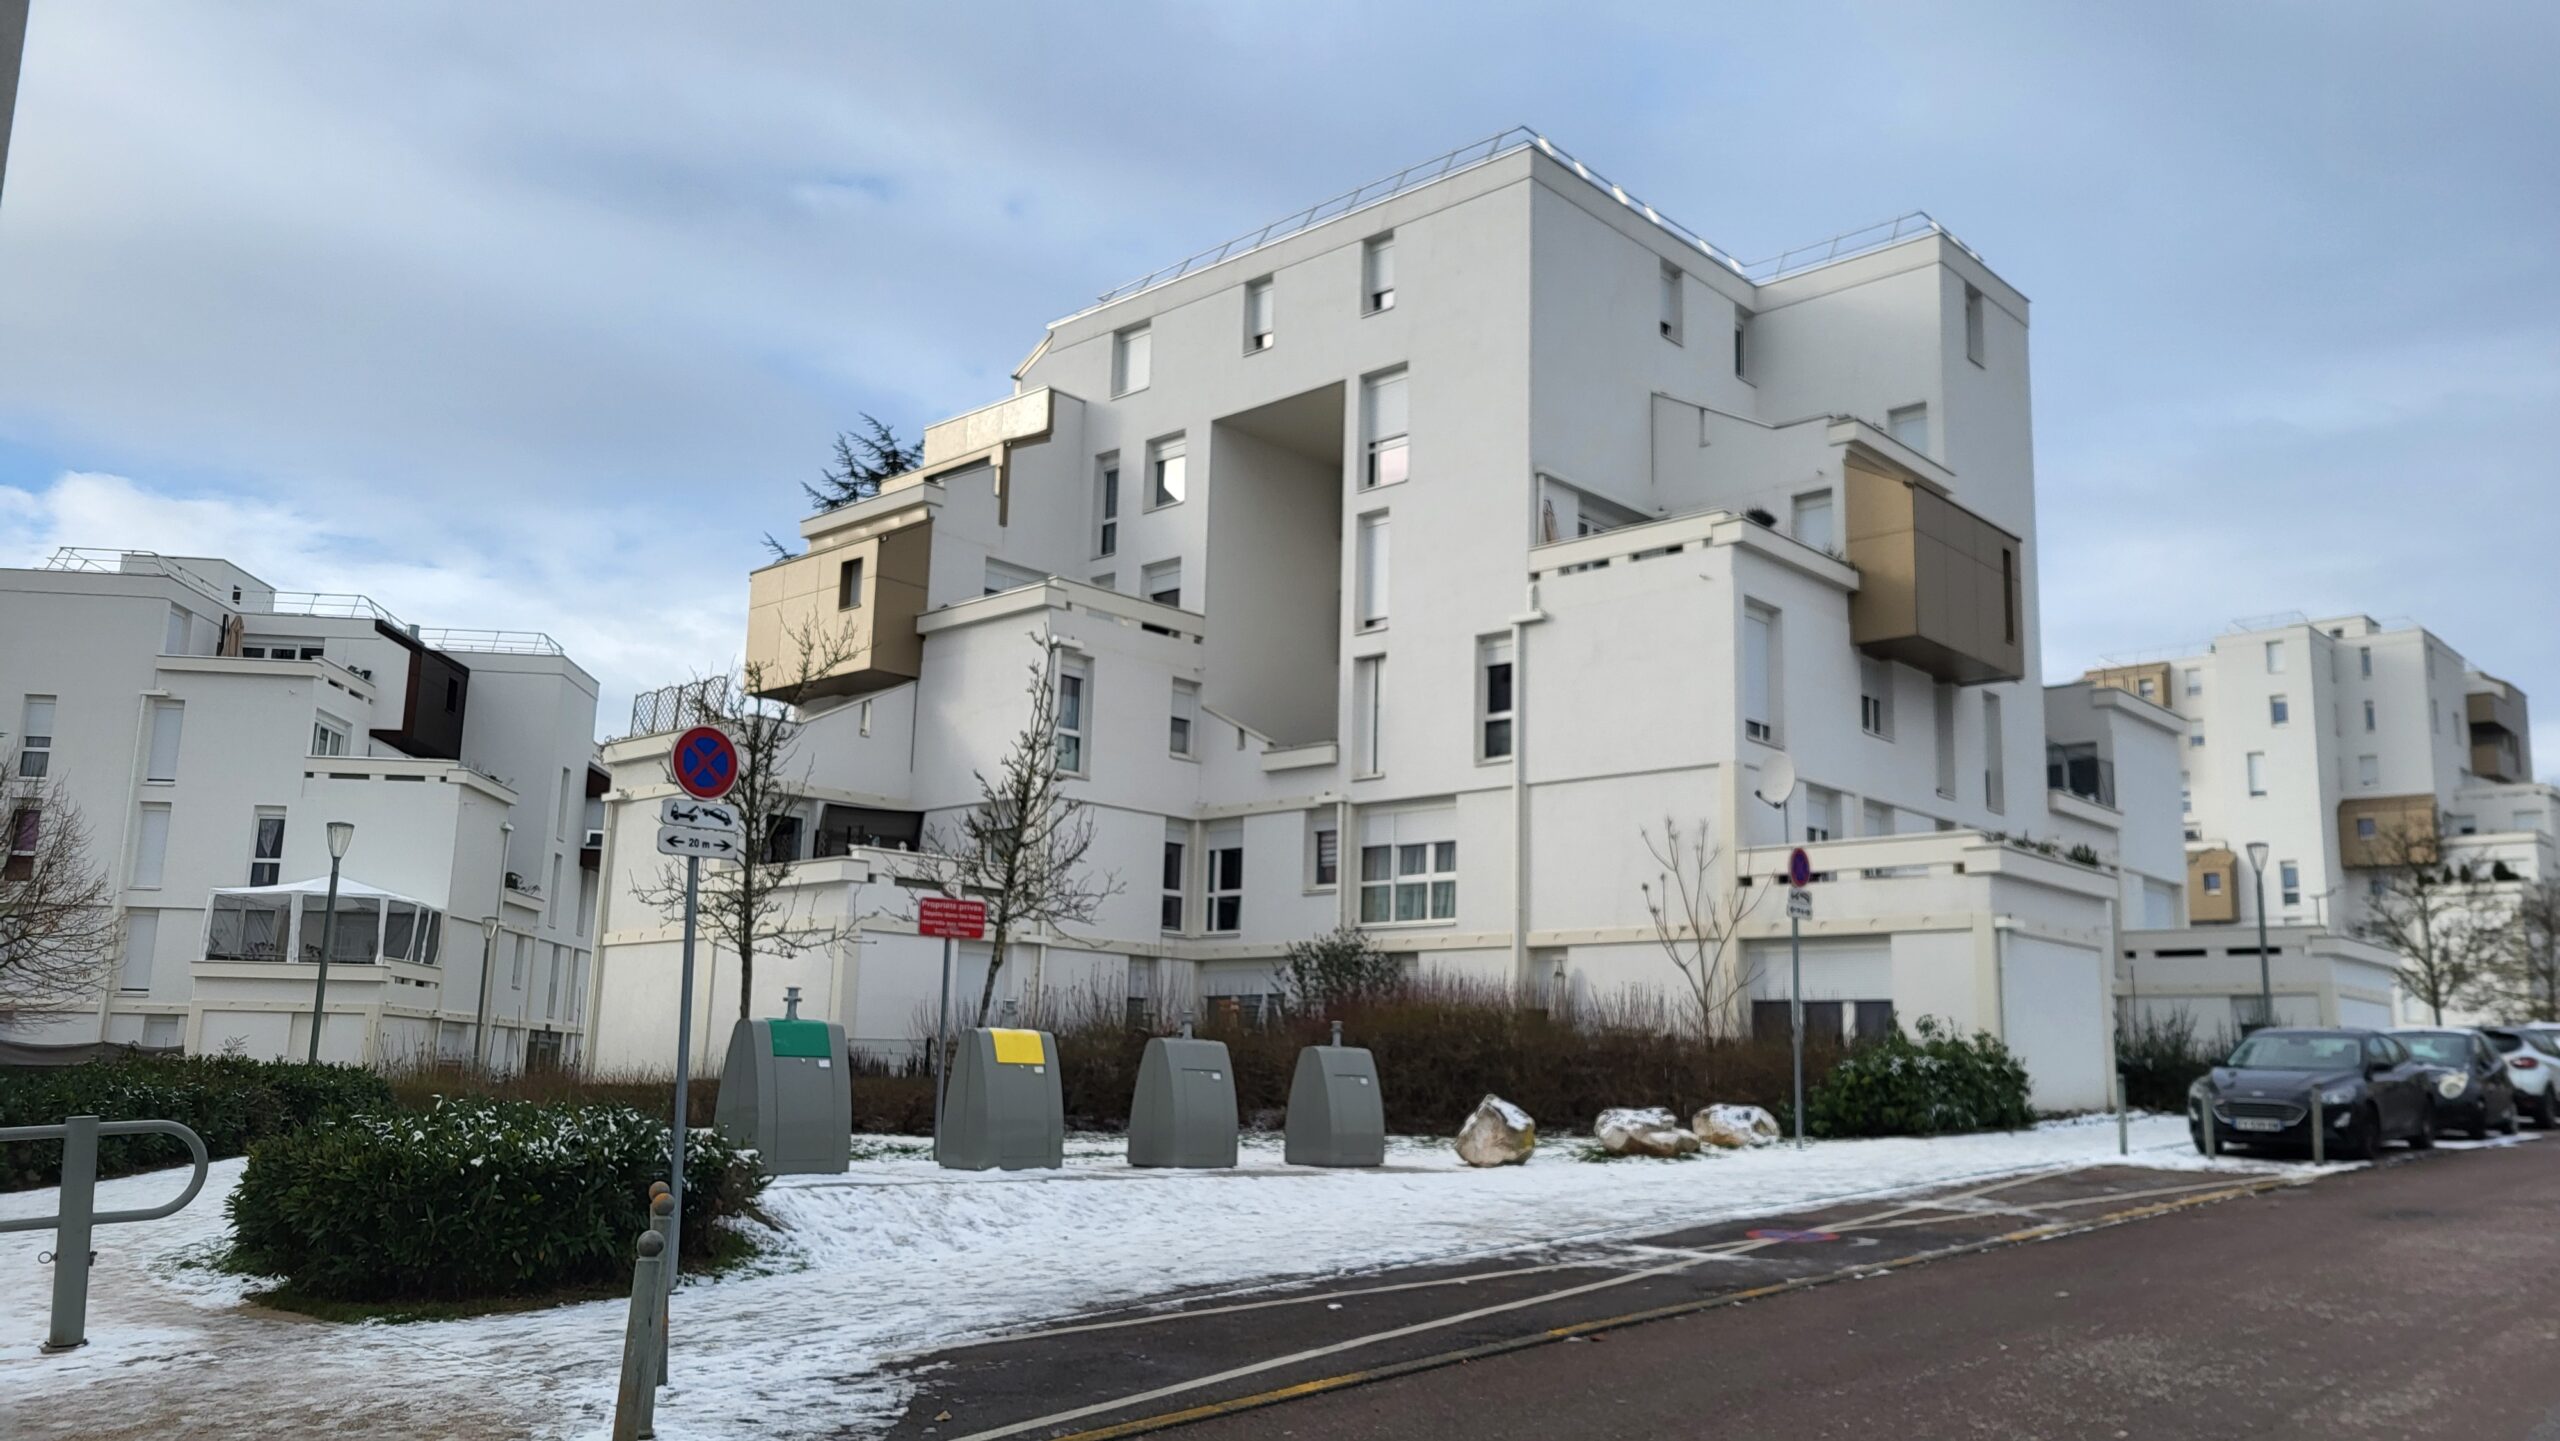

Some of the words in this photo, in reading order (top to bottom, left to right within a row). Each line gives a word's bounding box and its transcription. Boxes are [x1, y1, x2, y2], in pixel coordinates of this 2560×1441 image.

[689, 838, 699, 848] 20
[702, 841, 710, 849] m
[922, 900, 957, 910] Propriété
[959, 903, 983, 912] privée
